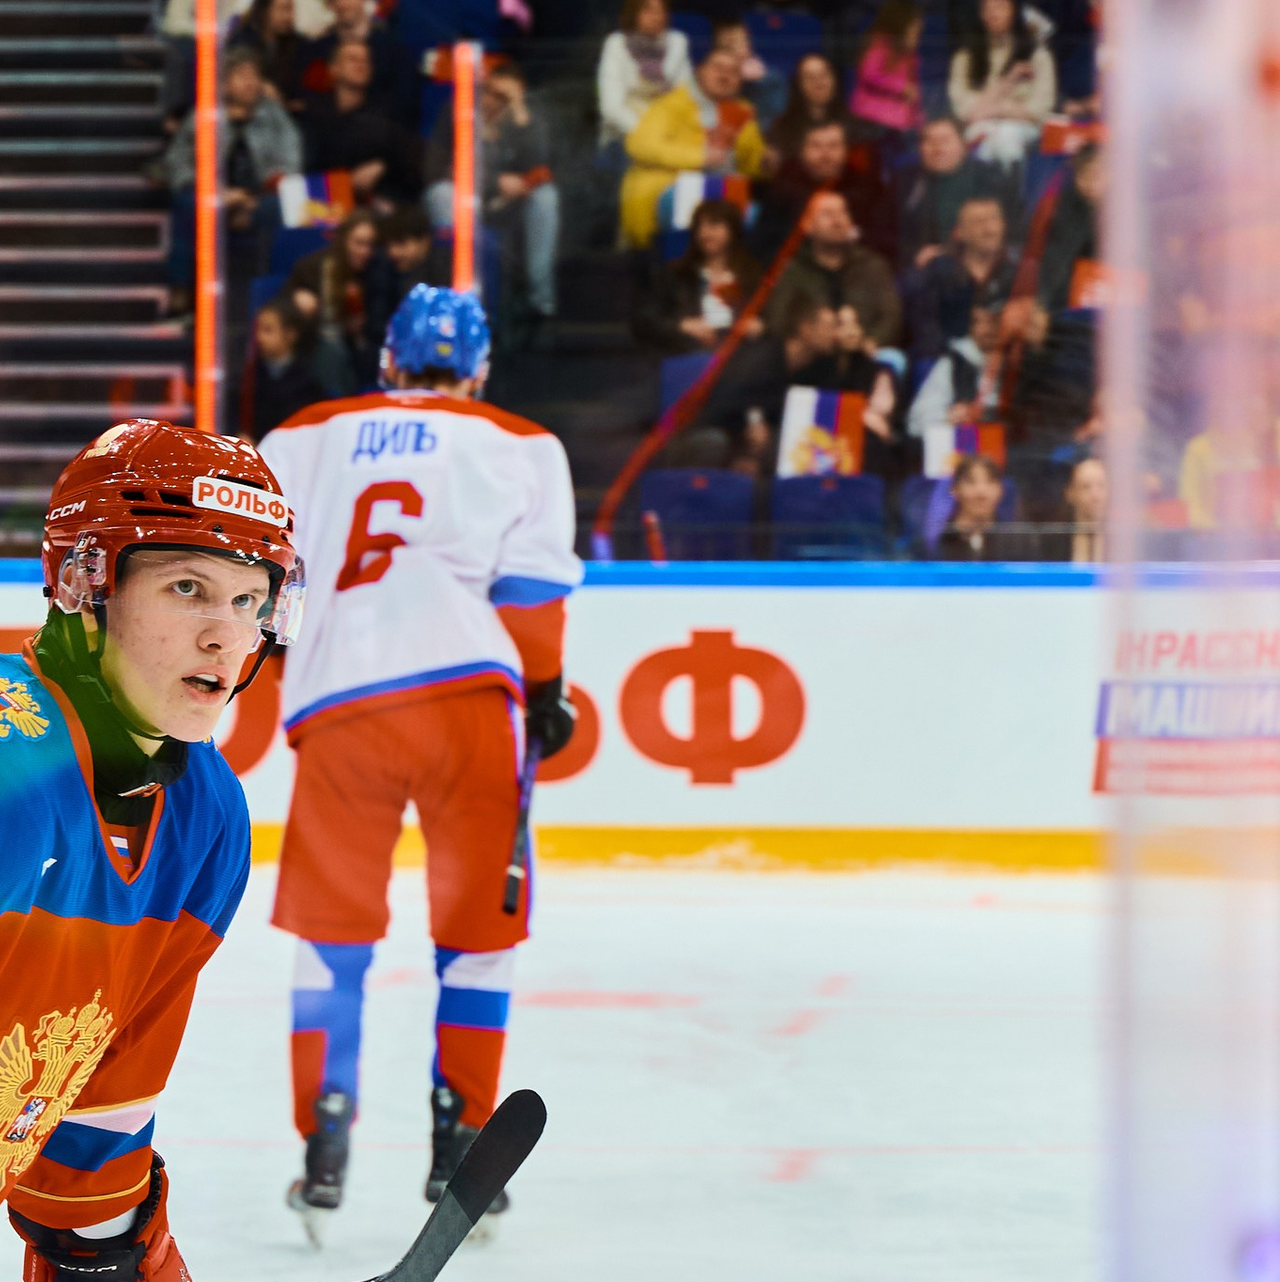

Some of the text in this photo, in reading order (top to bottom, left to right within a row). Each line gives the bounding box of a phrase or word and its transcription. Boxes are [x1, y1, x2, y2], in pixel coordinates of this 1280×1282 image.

[49, 499, 88, 521] CCM
[196, 481, 287, 521] РОЛЬФ
[335, 480, 425, 593] 6
